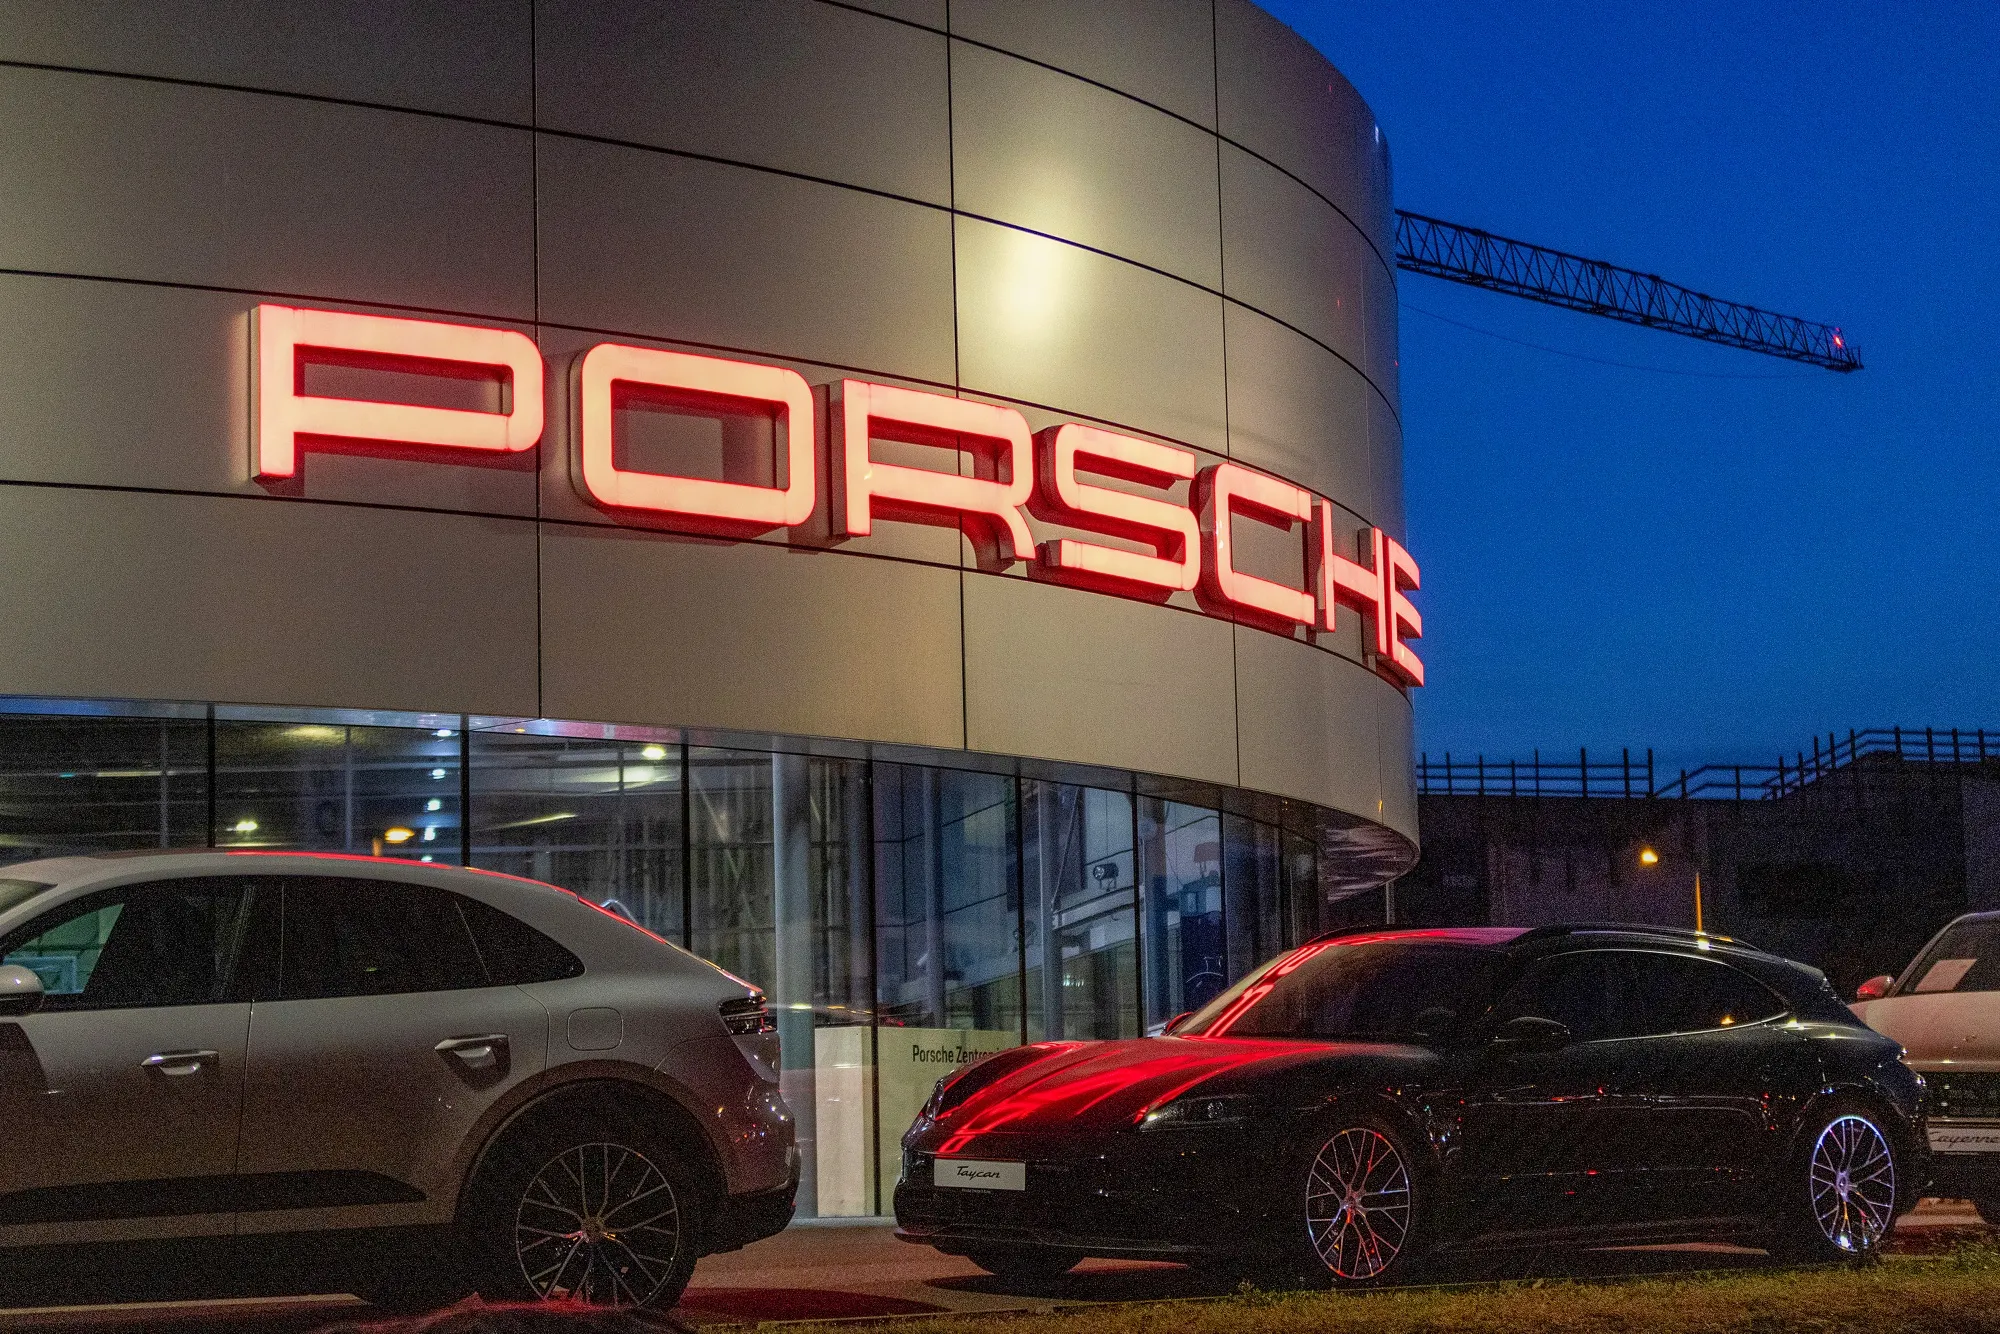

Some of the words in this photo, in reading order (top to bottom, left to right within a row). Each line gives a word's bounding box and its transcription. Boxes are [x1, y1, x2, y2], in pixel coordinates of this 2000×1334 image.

[258, 302, 1424, 687] PORSCHE
[912, 1044, 954, 1063] Porsche
[956, 1045, 995, 1064] Zentr
[956, 1165, 1001, 1181] Taycan
